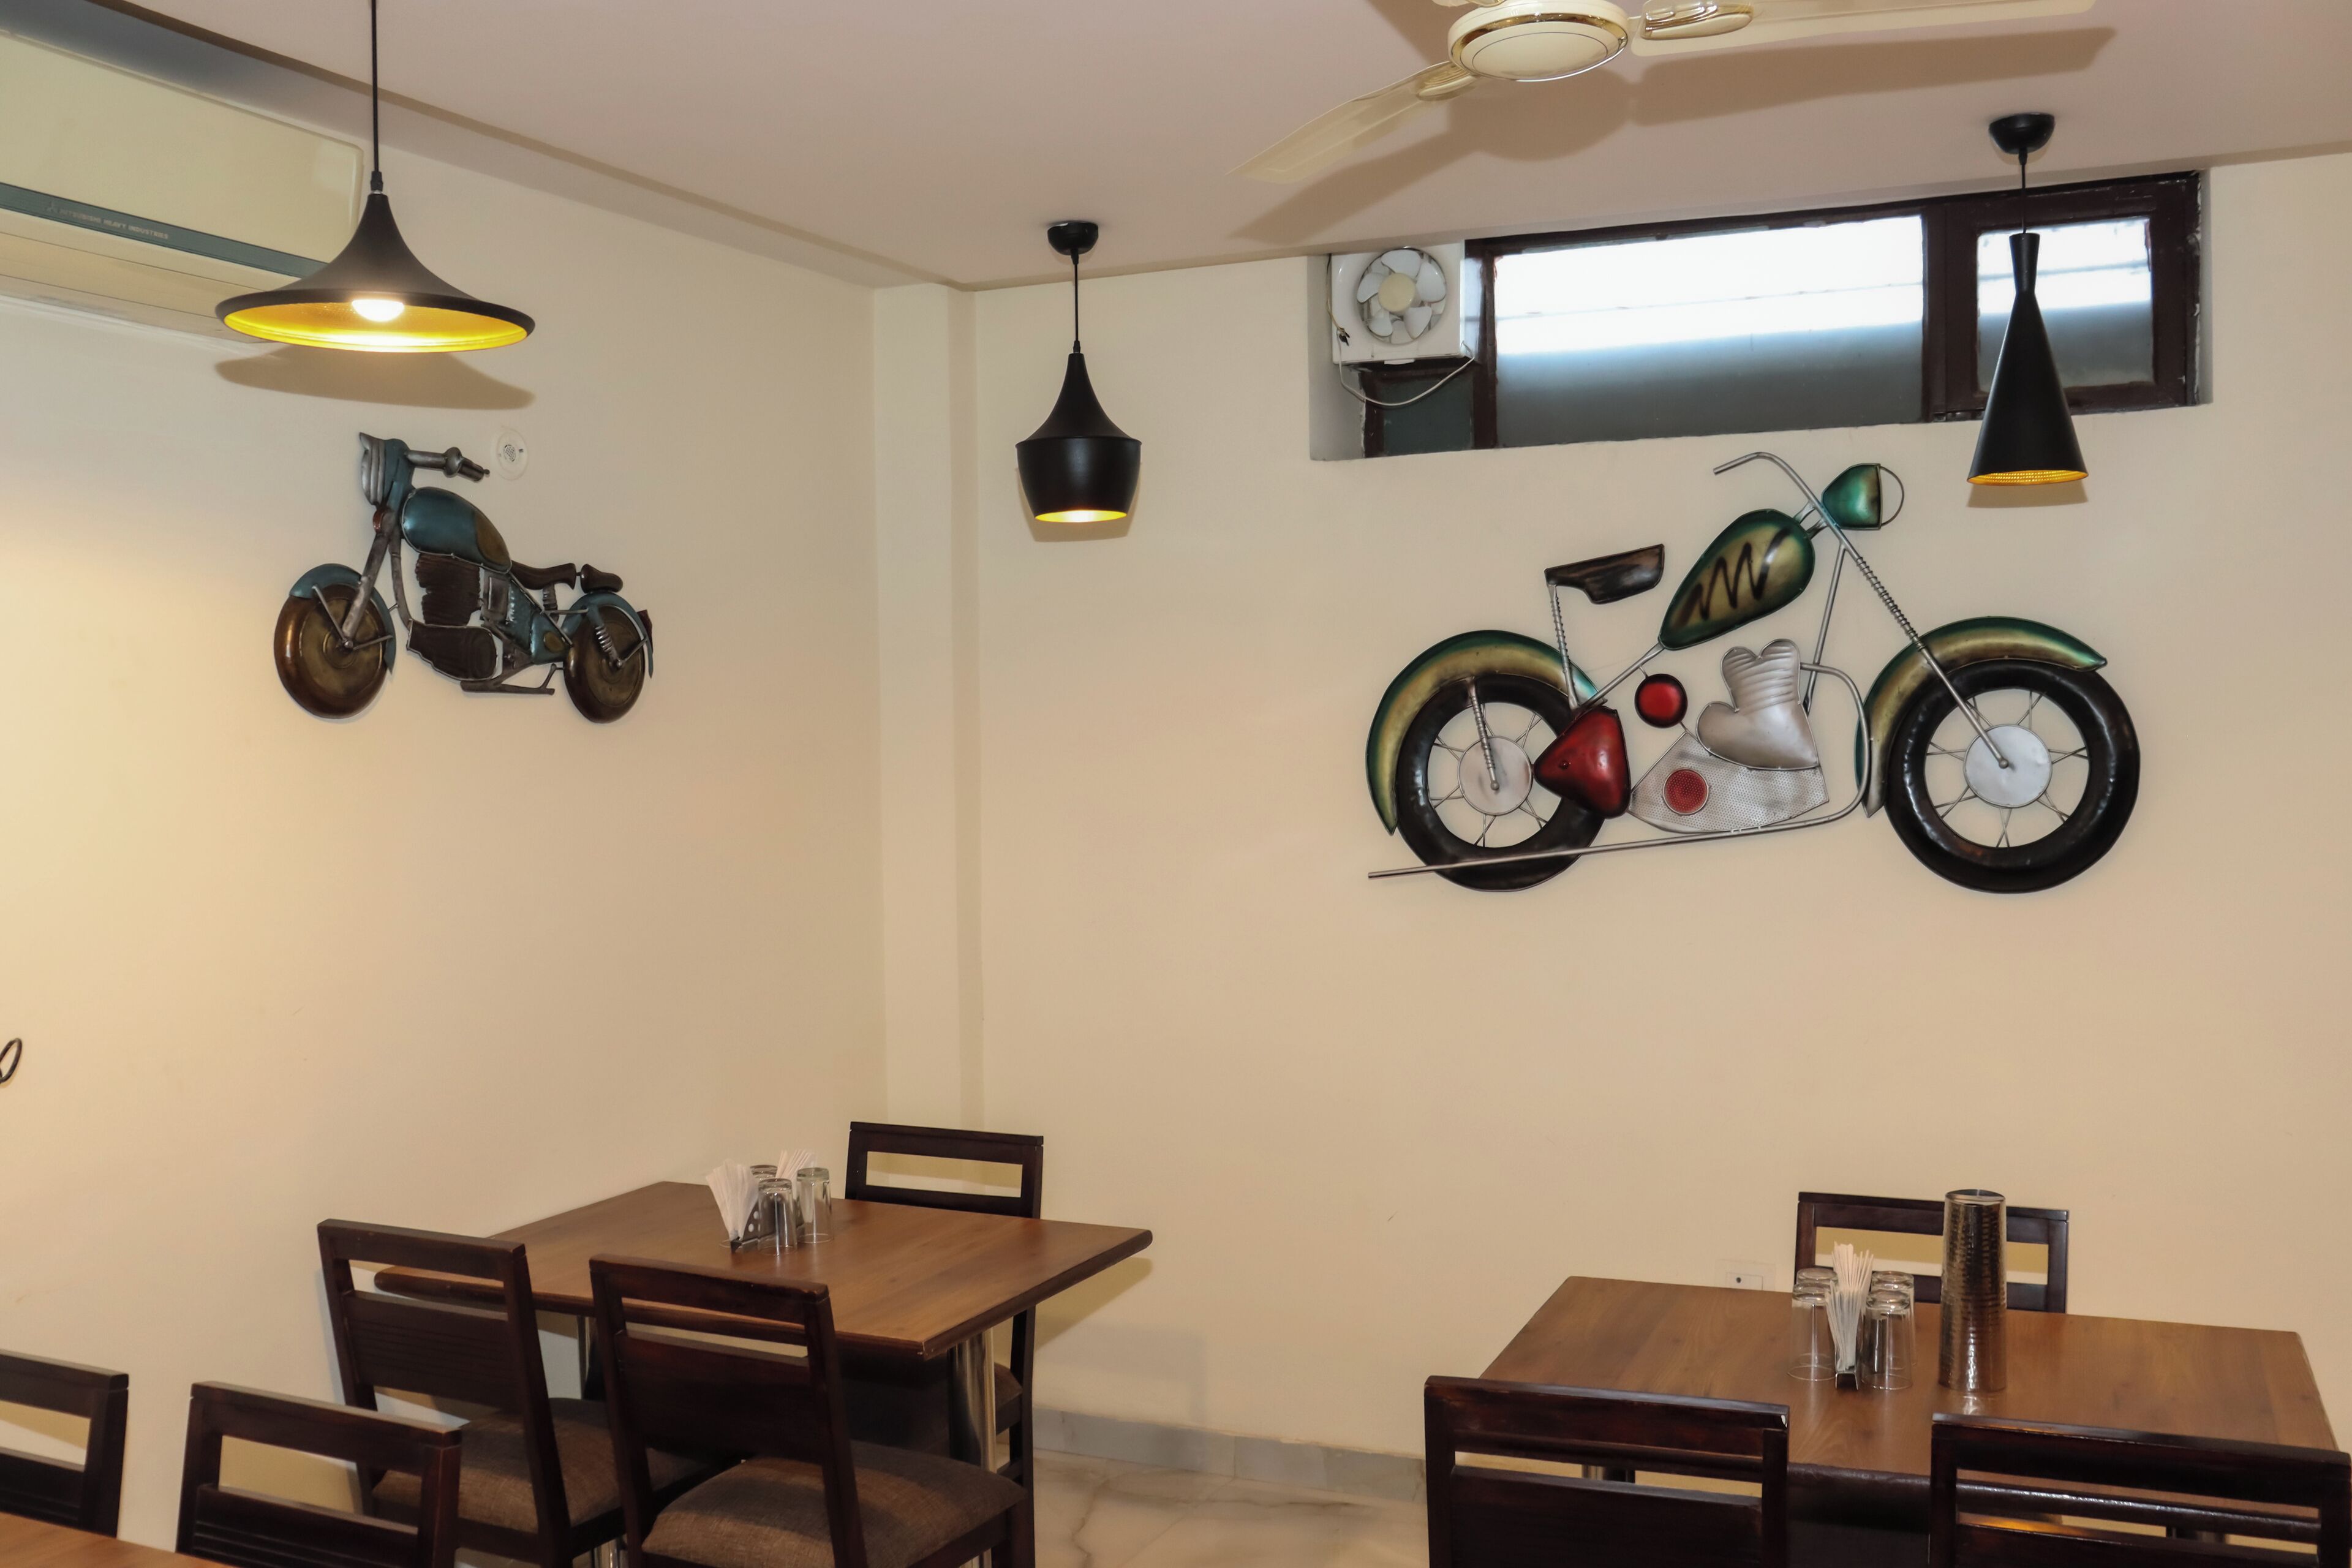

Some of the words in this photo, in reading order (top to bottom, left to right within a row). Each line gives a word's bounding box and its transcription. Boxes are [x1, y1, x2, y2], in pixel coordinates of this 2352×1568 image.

[59, 209, 101, 224] MITSUBISHI
[103, 219, 127, 229] HEAVY
[128, 225, 168, 239] INDUSTRIES
